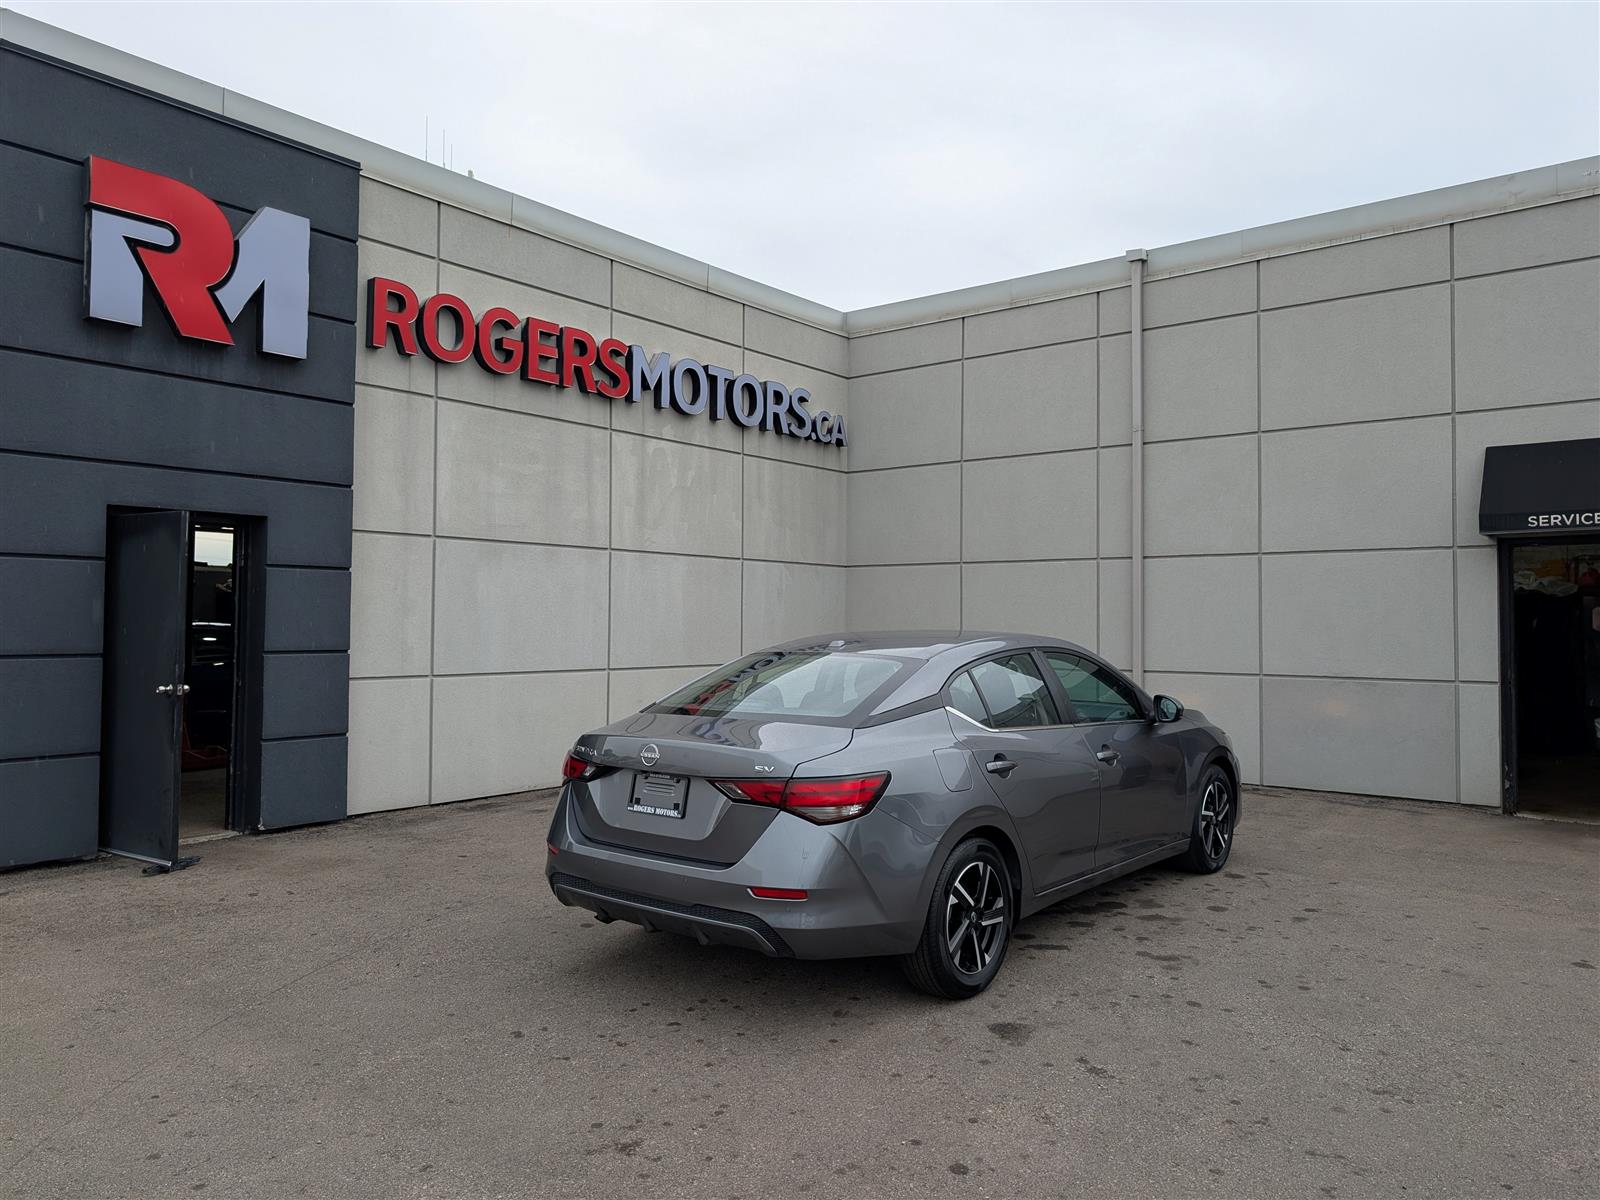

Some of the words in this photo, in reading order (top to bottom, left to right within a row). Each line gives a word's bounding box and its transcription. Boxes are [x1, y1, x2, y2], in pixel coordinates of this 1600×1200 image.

[1527, 512, 1600, 528] SERVICE
[754, 765, 775, 773] SV
[633, 804, 655, 814] ROGERS
